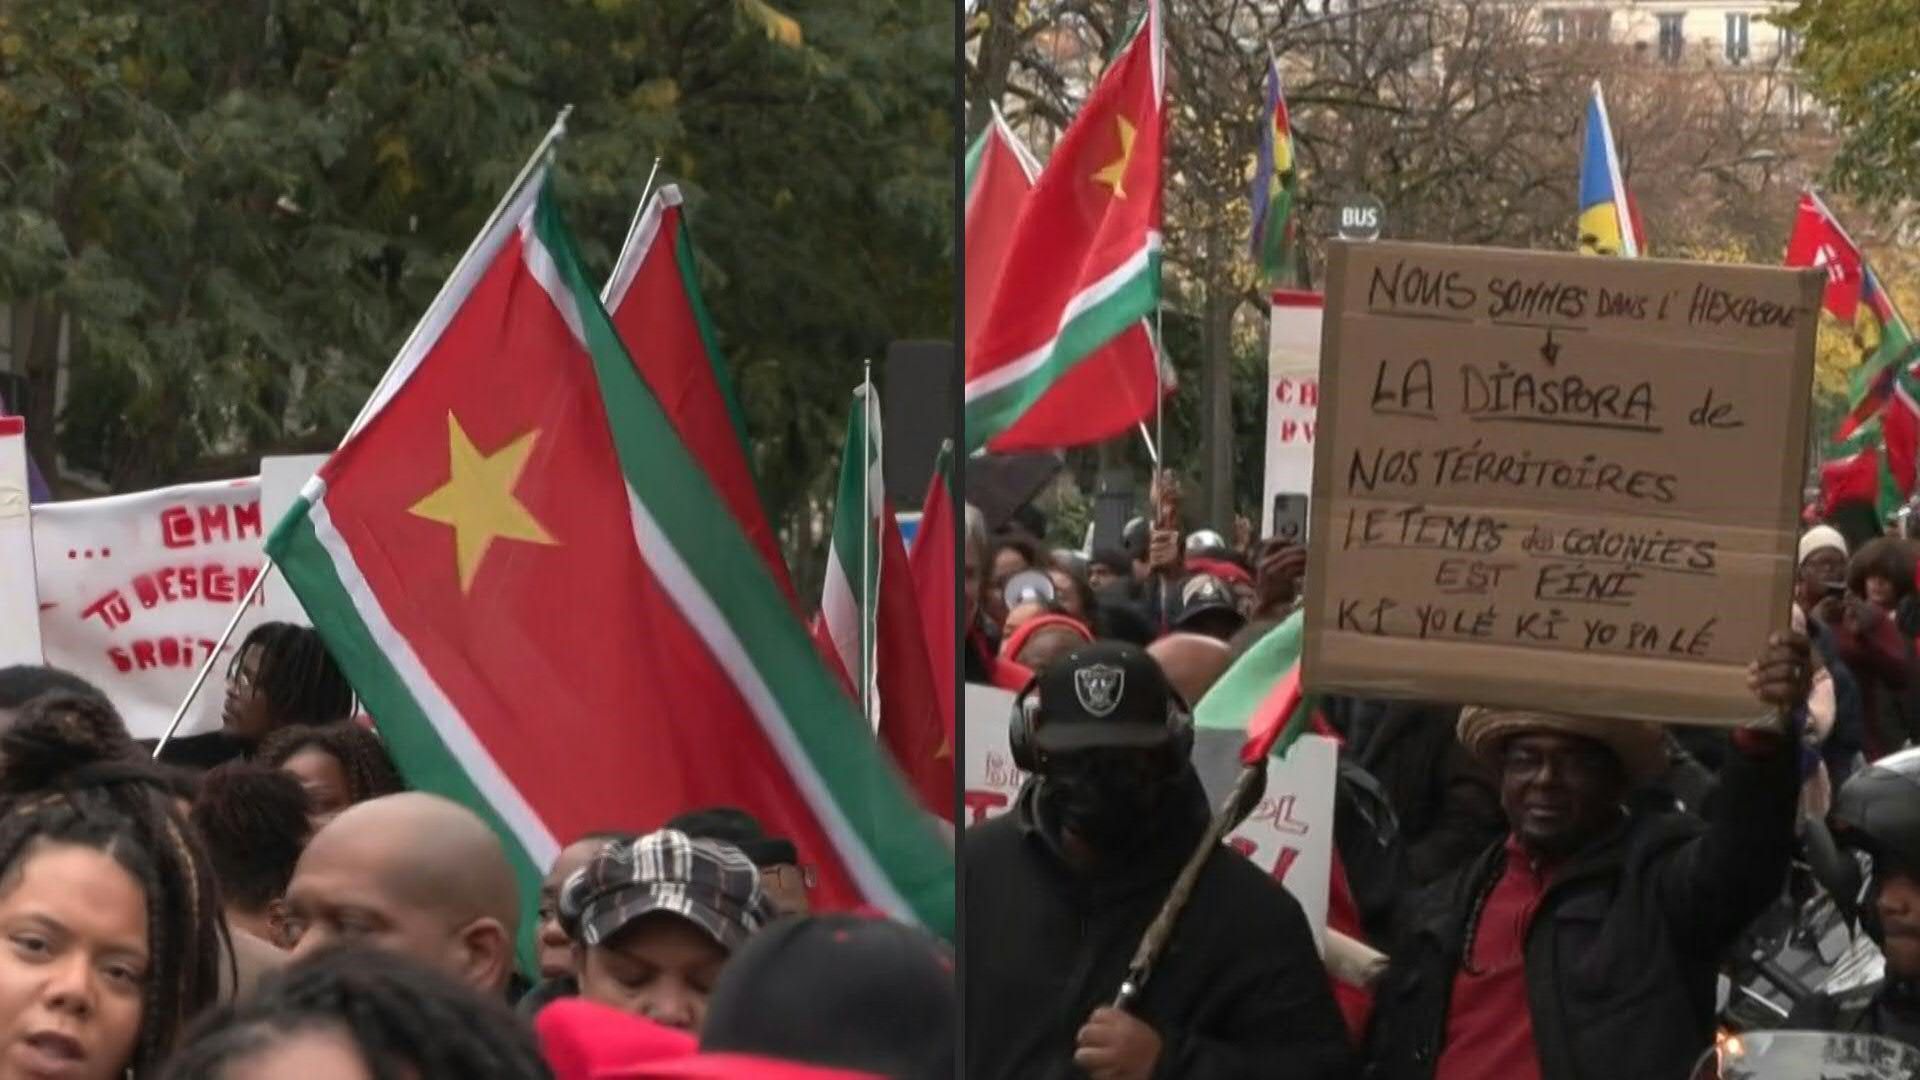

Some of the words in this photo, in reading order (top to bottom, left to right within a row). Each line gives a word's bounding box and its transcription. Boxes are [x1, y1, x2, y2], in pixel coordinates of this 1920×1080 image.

[1341, 206, 1378, 227] BUS
[1368, 263, 1476, 310] NOUS
[1488, 277, 1588, 318] SOMMES
[1595, 285, 1648, 320] DANS
[1372, 359, 1435, 411] LA
[1460, 361, 1655, 422] DIASPORA
[1688, 387, 1745, 428] de
[1347, 447, 1423, 491] NOS
[1396, 504, 1508, 552] TEMPS
[1434, 556, 1519, 587] EST
[1535, 562, 1645, 599] FINI
[80, 588, 131, 629] TU
[1337, 597, 1398, 636] KI
[1515, 607, 1570, 641] KI
